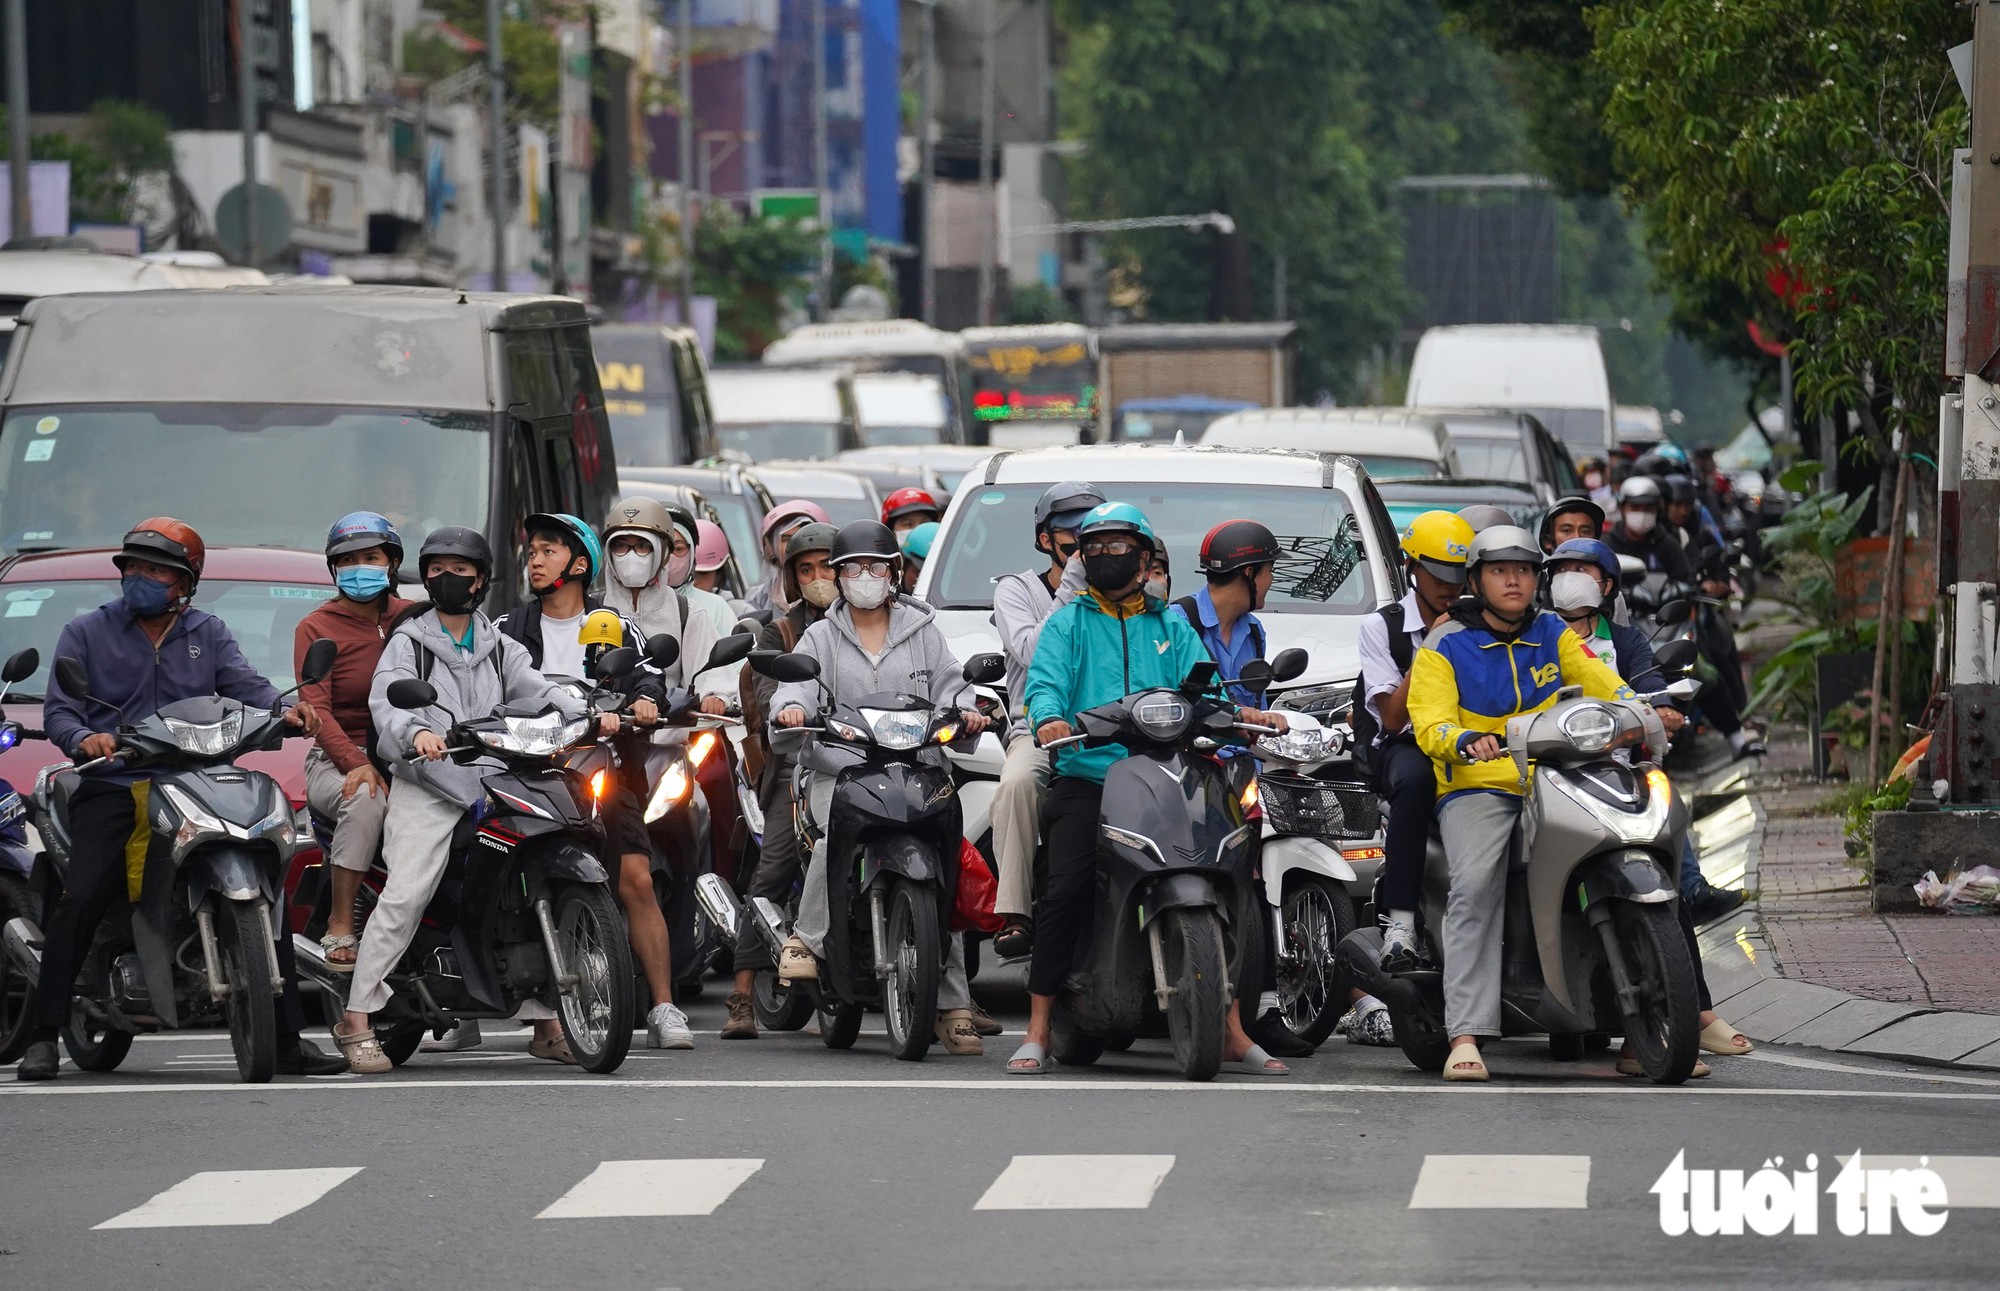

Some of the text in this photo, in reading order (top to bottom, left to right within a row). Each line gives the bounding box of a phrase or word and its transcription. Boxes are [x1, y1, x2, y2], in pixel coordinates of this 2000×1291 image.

[1447, 539, 1468, 557] be
[1529, 662, 1560, 688] be
[541, 767, 566, 775] HONDA
[884, 761, 912, 769] HONDA
[478, 835, 510, 854] HONDA
